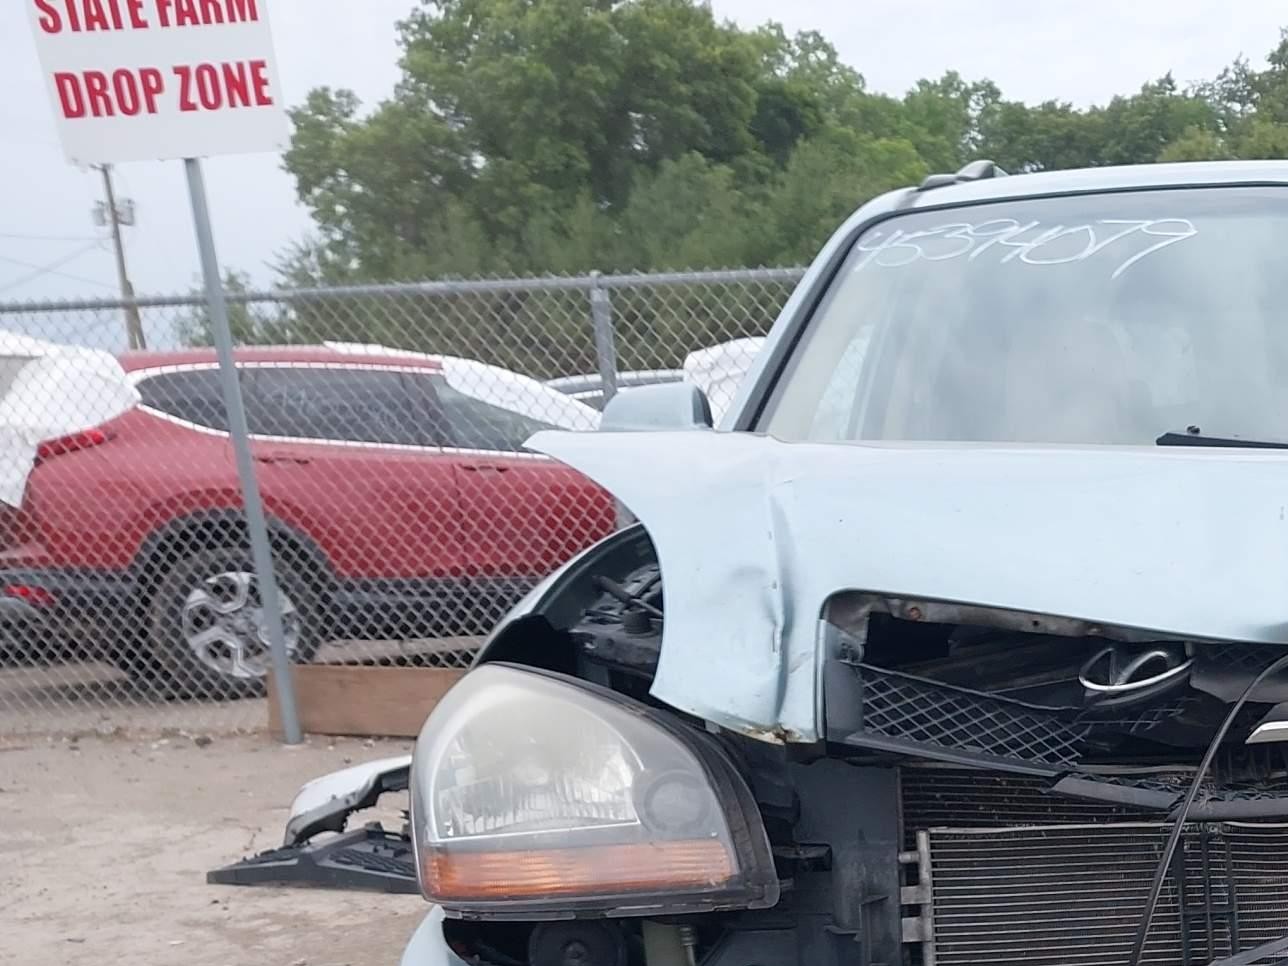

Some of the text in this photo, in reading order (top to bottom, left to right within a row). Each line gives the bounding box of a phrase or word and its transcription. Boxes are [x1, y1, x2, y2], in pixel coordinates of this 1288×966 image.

[54, 60, 273, 118] DROP ZONE
[854, 219, 1198, 279] 45394079
